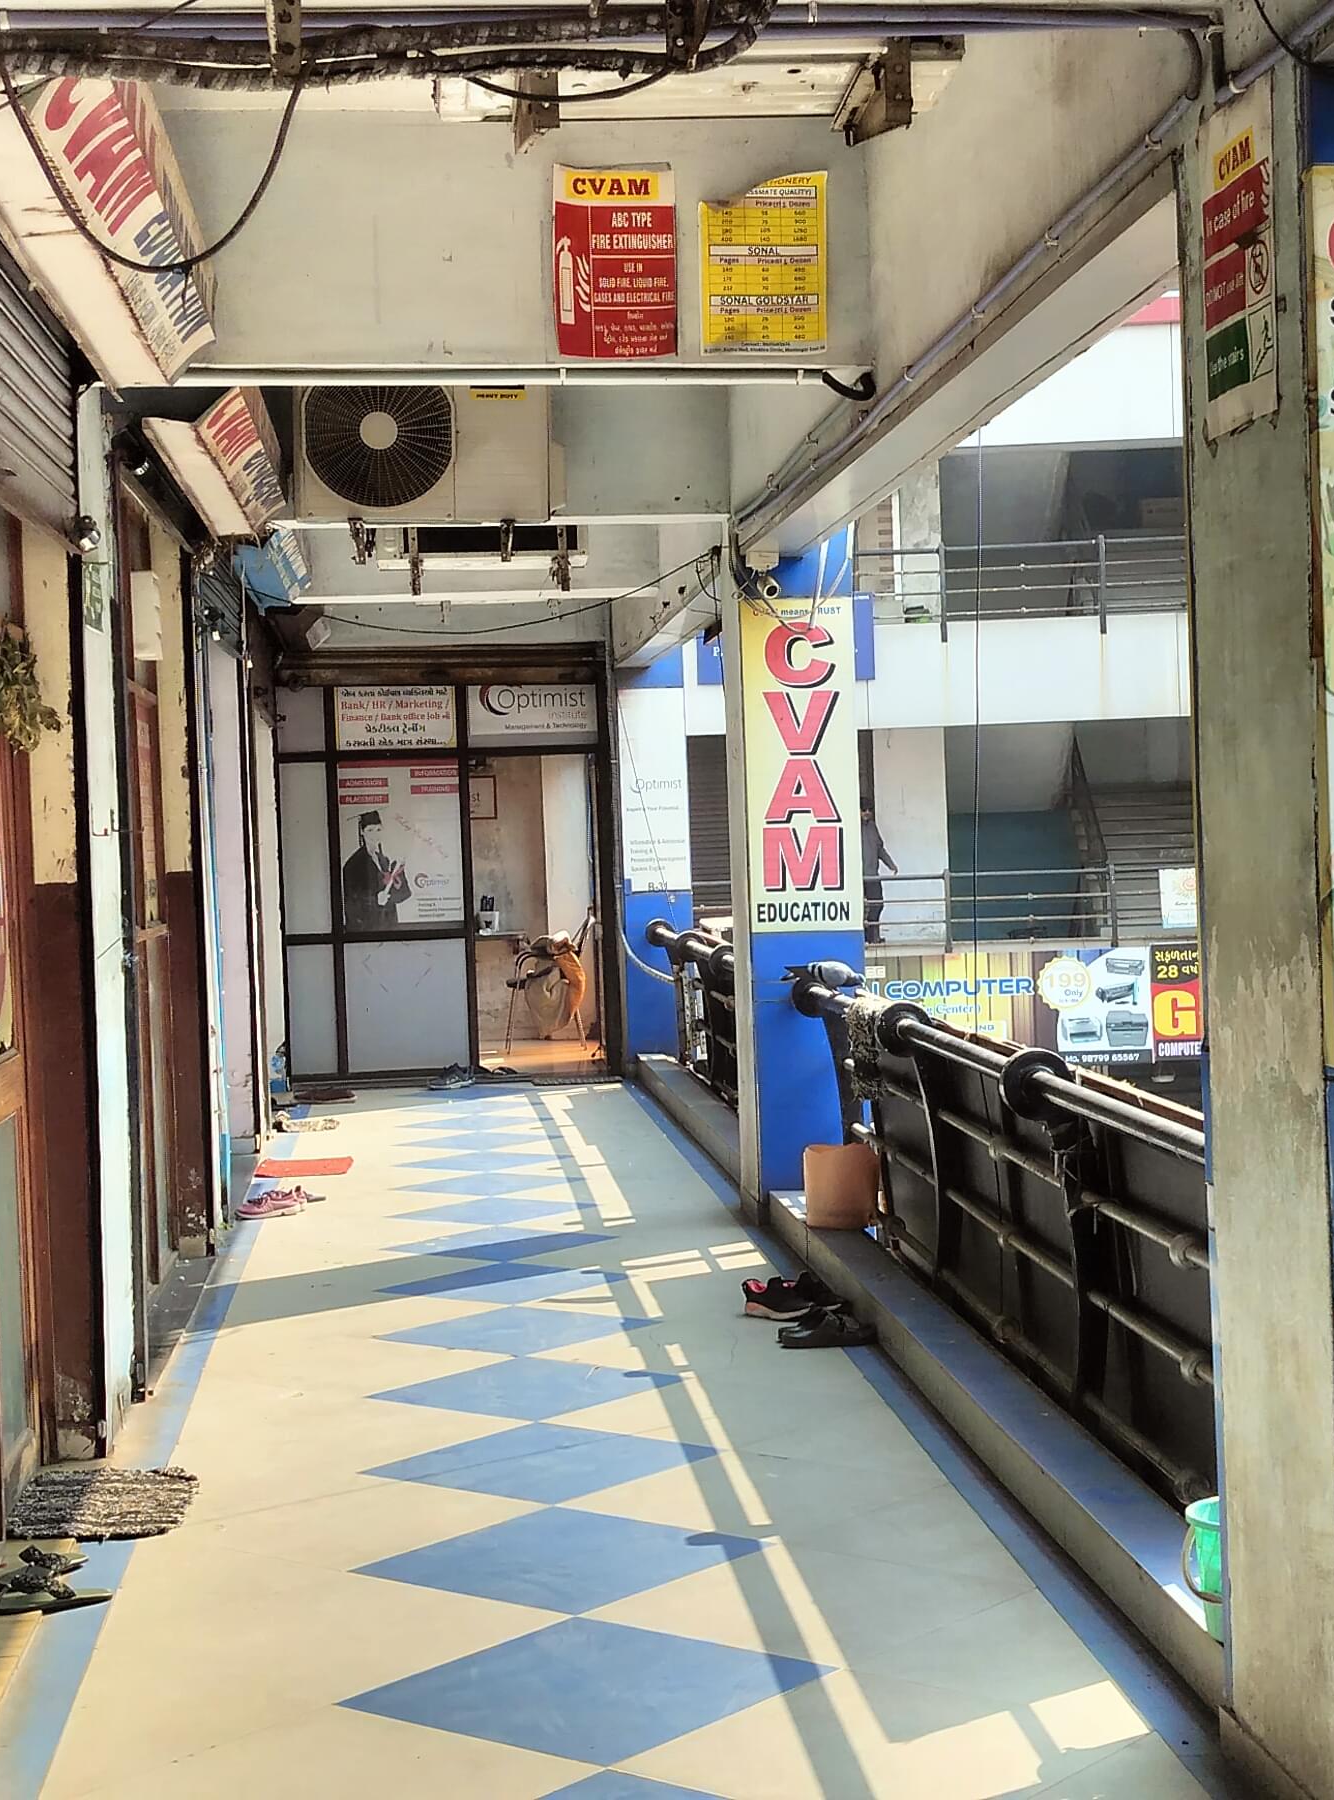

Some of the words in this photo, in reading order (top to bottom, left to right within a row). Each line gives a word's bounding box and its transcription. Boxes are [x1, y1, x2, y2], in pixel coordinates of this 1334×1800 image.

[1219, 136, 1251, 180] CVAM
[573, 177, 650, 195] CVAM
[1214, 207, 1230, 231] case
[1233, 194, 1240, 218] of
[1241, 189, 1255, 215] fire
[612, 212, 629, 227] ABC
[631, 212, 652, 227] TYPE
[592, 234, 610, 249] FIRE
[613, 234, 673, 249] EXTINGUISHER
[748, 247, 779, 255] SONAL
[624, 263, 635, 272] USE
[637, 263, 642, 272] IN
[599, 278, 615, 288] SOLID
[634, 278, 652, 288] LIQUID
[594, 293, 611, 302] GASES
[614, 293, 625, 302] AND
[627, 292, 660, 302] ELECTRICAL
[720, 296, 751, 304] SONAL
[756, 296, 808, 304] GOLDSTAR
[372, 701, 385, 709] HR
[396, 700, 442, 710] Marketing
[498, 688, 586, 713] Optimist
[763, 622, 844, 890] CVAM
[636, 779, 682, 792] Optimist
[757, 901, 850, 922] EDUCATION
[1157, 965, 1178, 978] 28
[1046, 972, 1086, 988] 199
[886, 978, 1032, 998] COMPUTER
[1065, 989, 1083, 998] Only
[1159, 1041, 1201, 1057] COMPUTE
